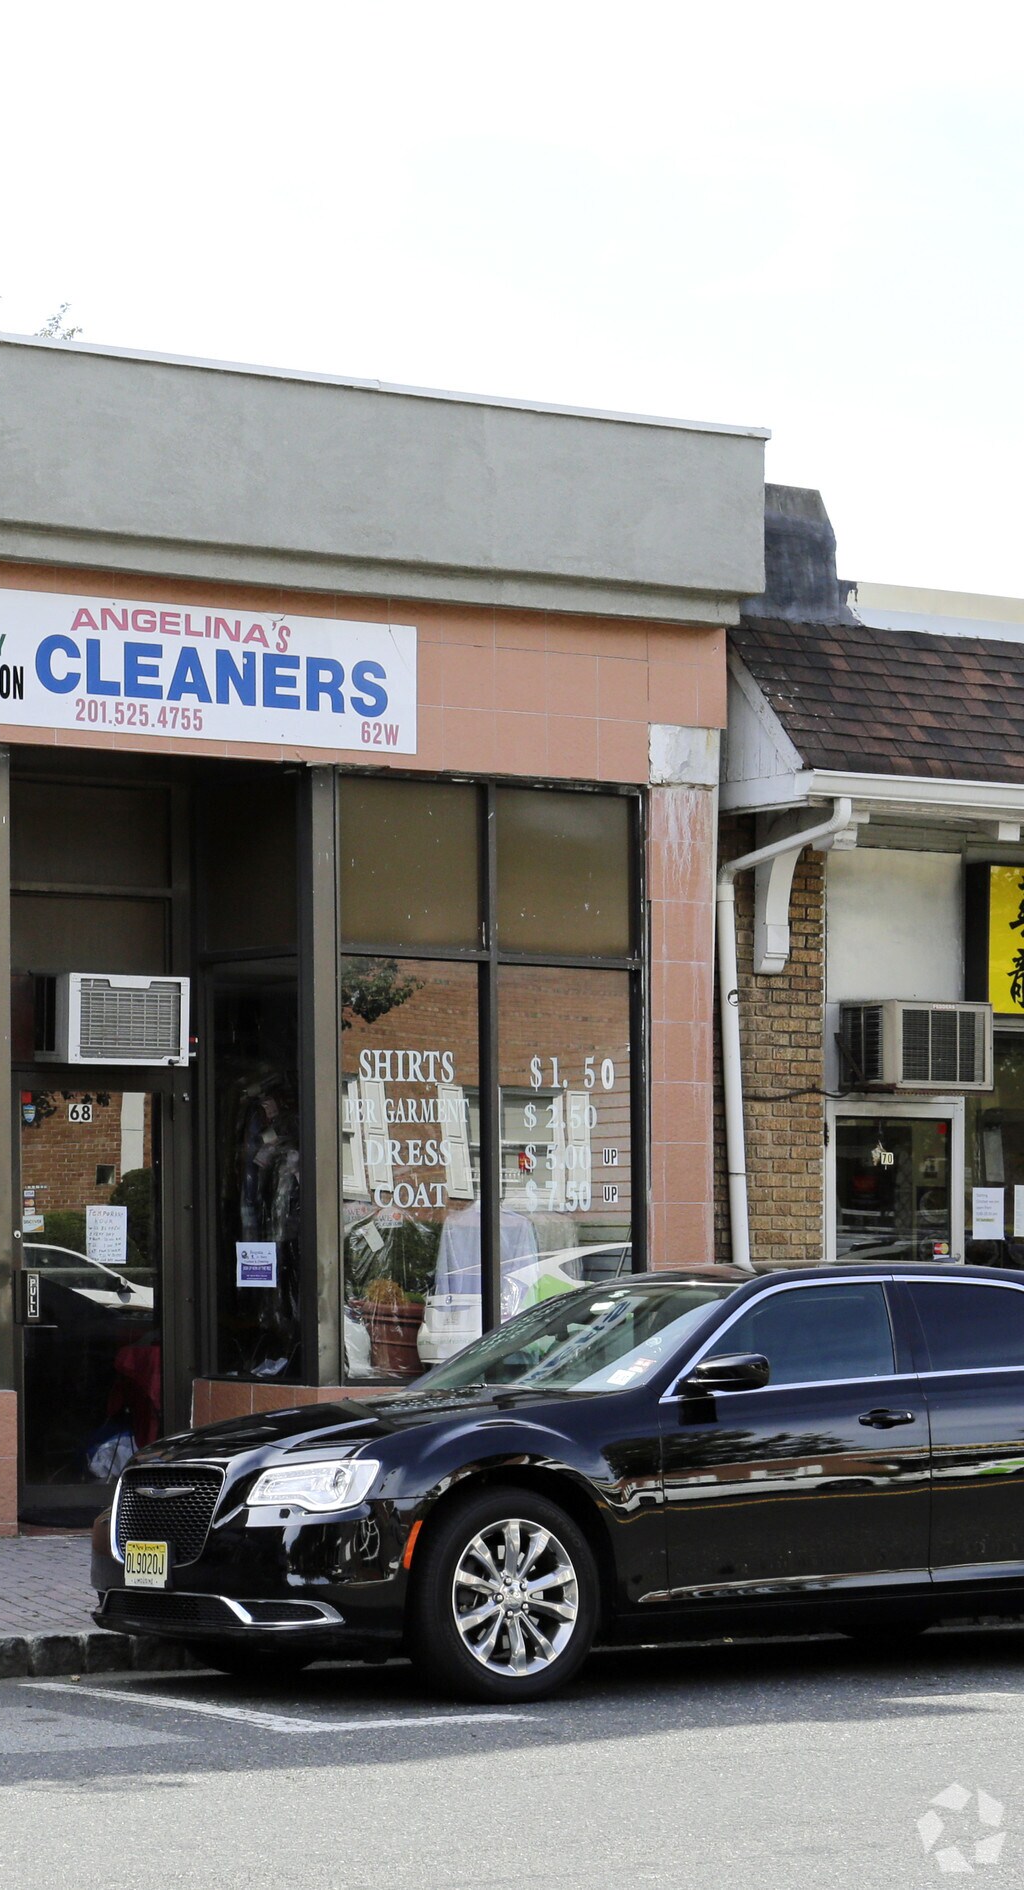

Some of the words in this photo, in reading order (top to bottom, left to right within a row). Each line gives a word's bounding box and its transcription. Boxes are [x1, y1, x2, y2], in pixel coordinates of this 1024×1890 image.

[35, 633, 388, 718] CLEANERS
[75, 698, 203, 732] 201.525.4755
[361, 721, 399, 746] 62W
[359, 1049, 454, 1083] SHIRTS
[70, 1104, 91, 1121] 68
[344, 1098, 380, 1123] PER
[384, 1098, 469, 1123] GARMENT
[364, 1139, 452, 1166] DRESS
[604, 1149, 617, 1164] UP
[882, 1153, 892, 1164] 70
[375, 1182, 448, 1208] COAT
[604, 1186, 617, 1202] UP
